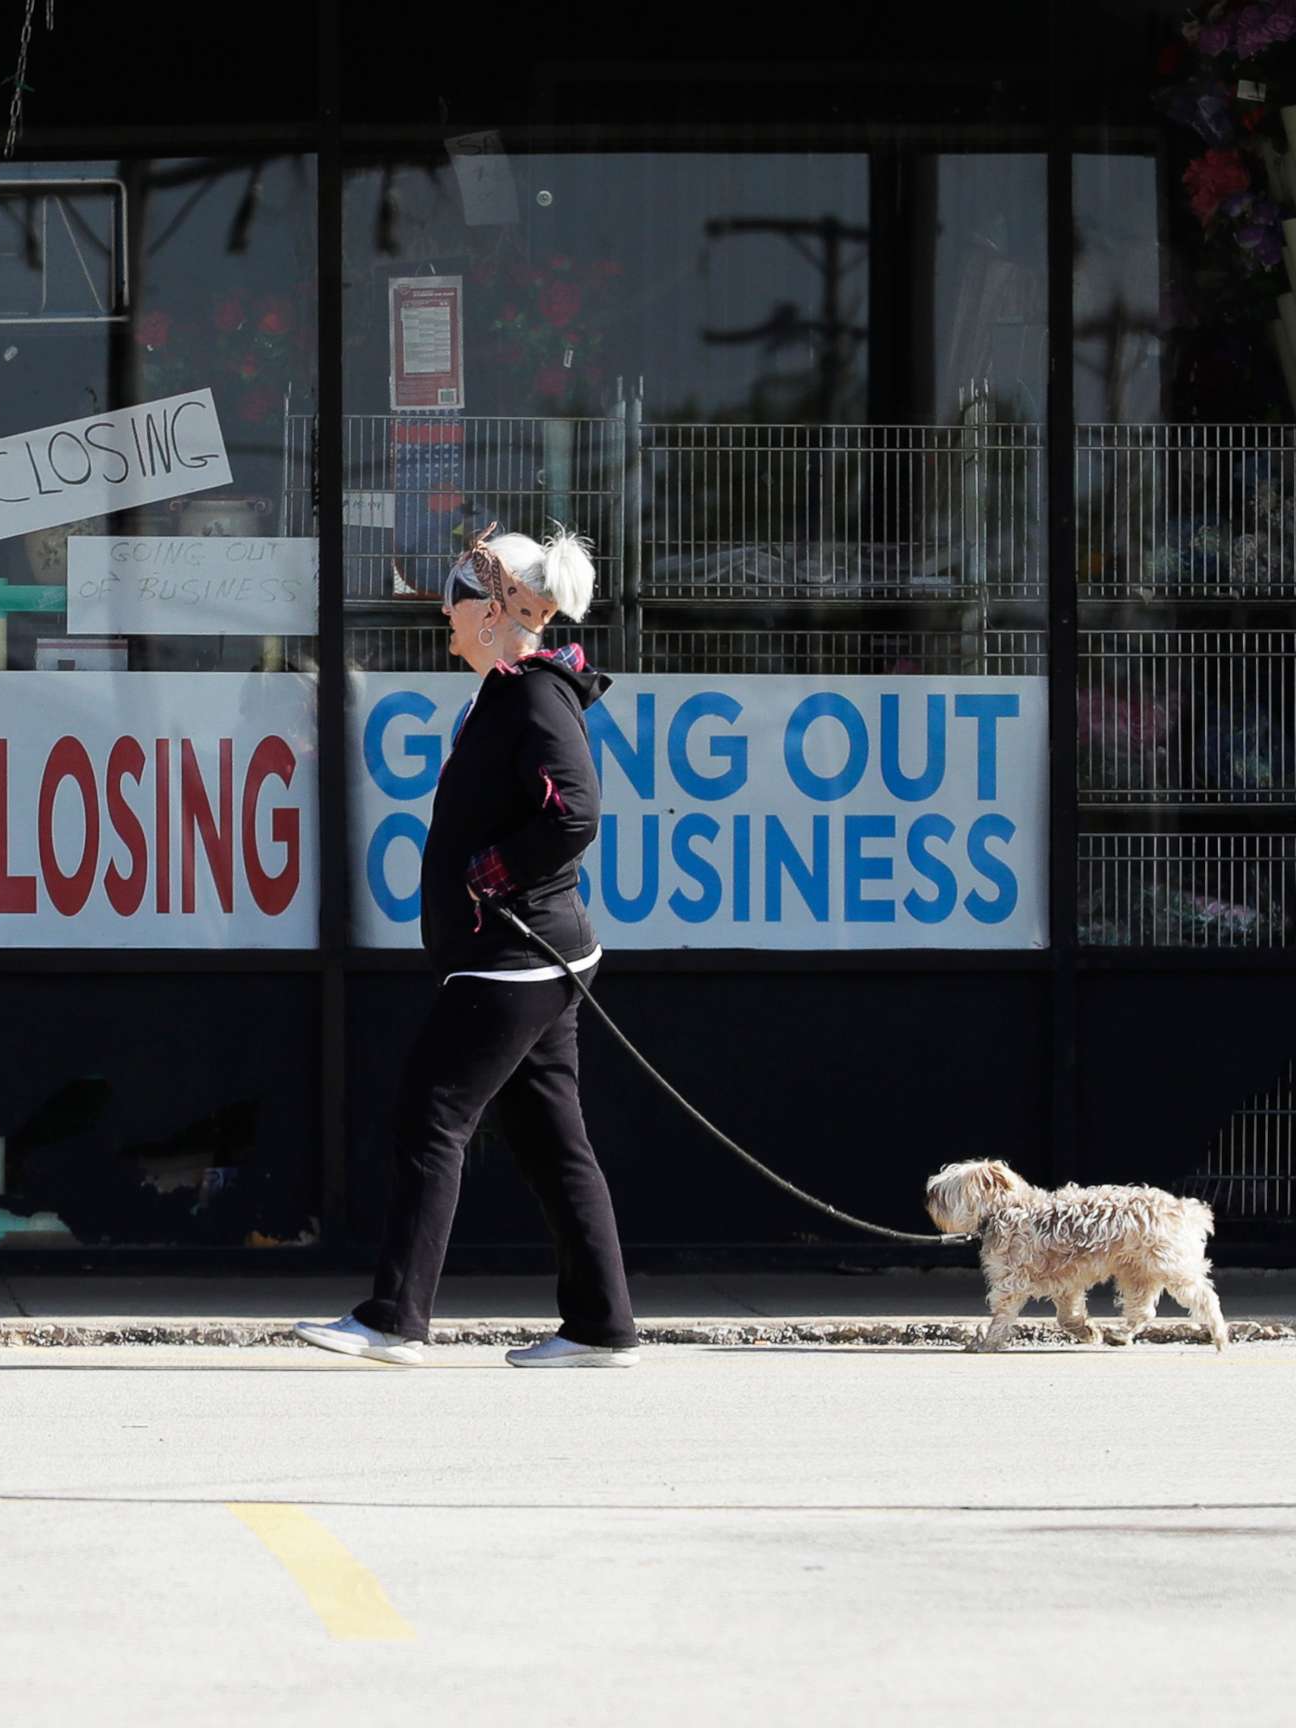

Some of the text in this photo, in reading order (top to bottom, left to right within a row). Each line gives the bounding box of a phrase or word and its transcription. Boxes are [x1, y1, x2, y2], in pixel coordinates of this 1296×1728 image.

[110, 541, 284, 566] GOING OUT
[137, 576, 303, 606] BUSINESS
[363, 691, 1020, 800] GNG OUT
[367, 812, 1019, 924] O USINESS
